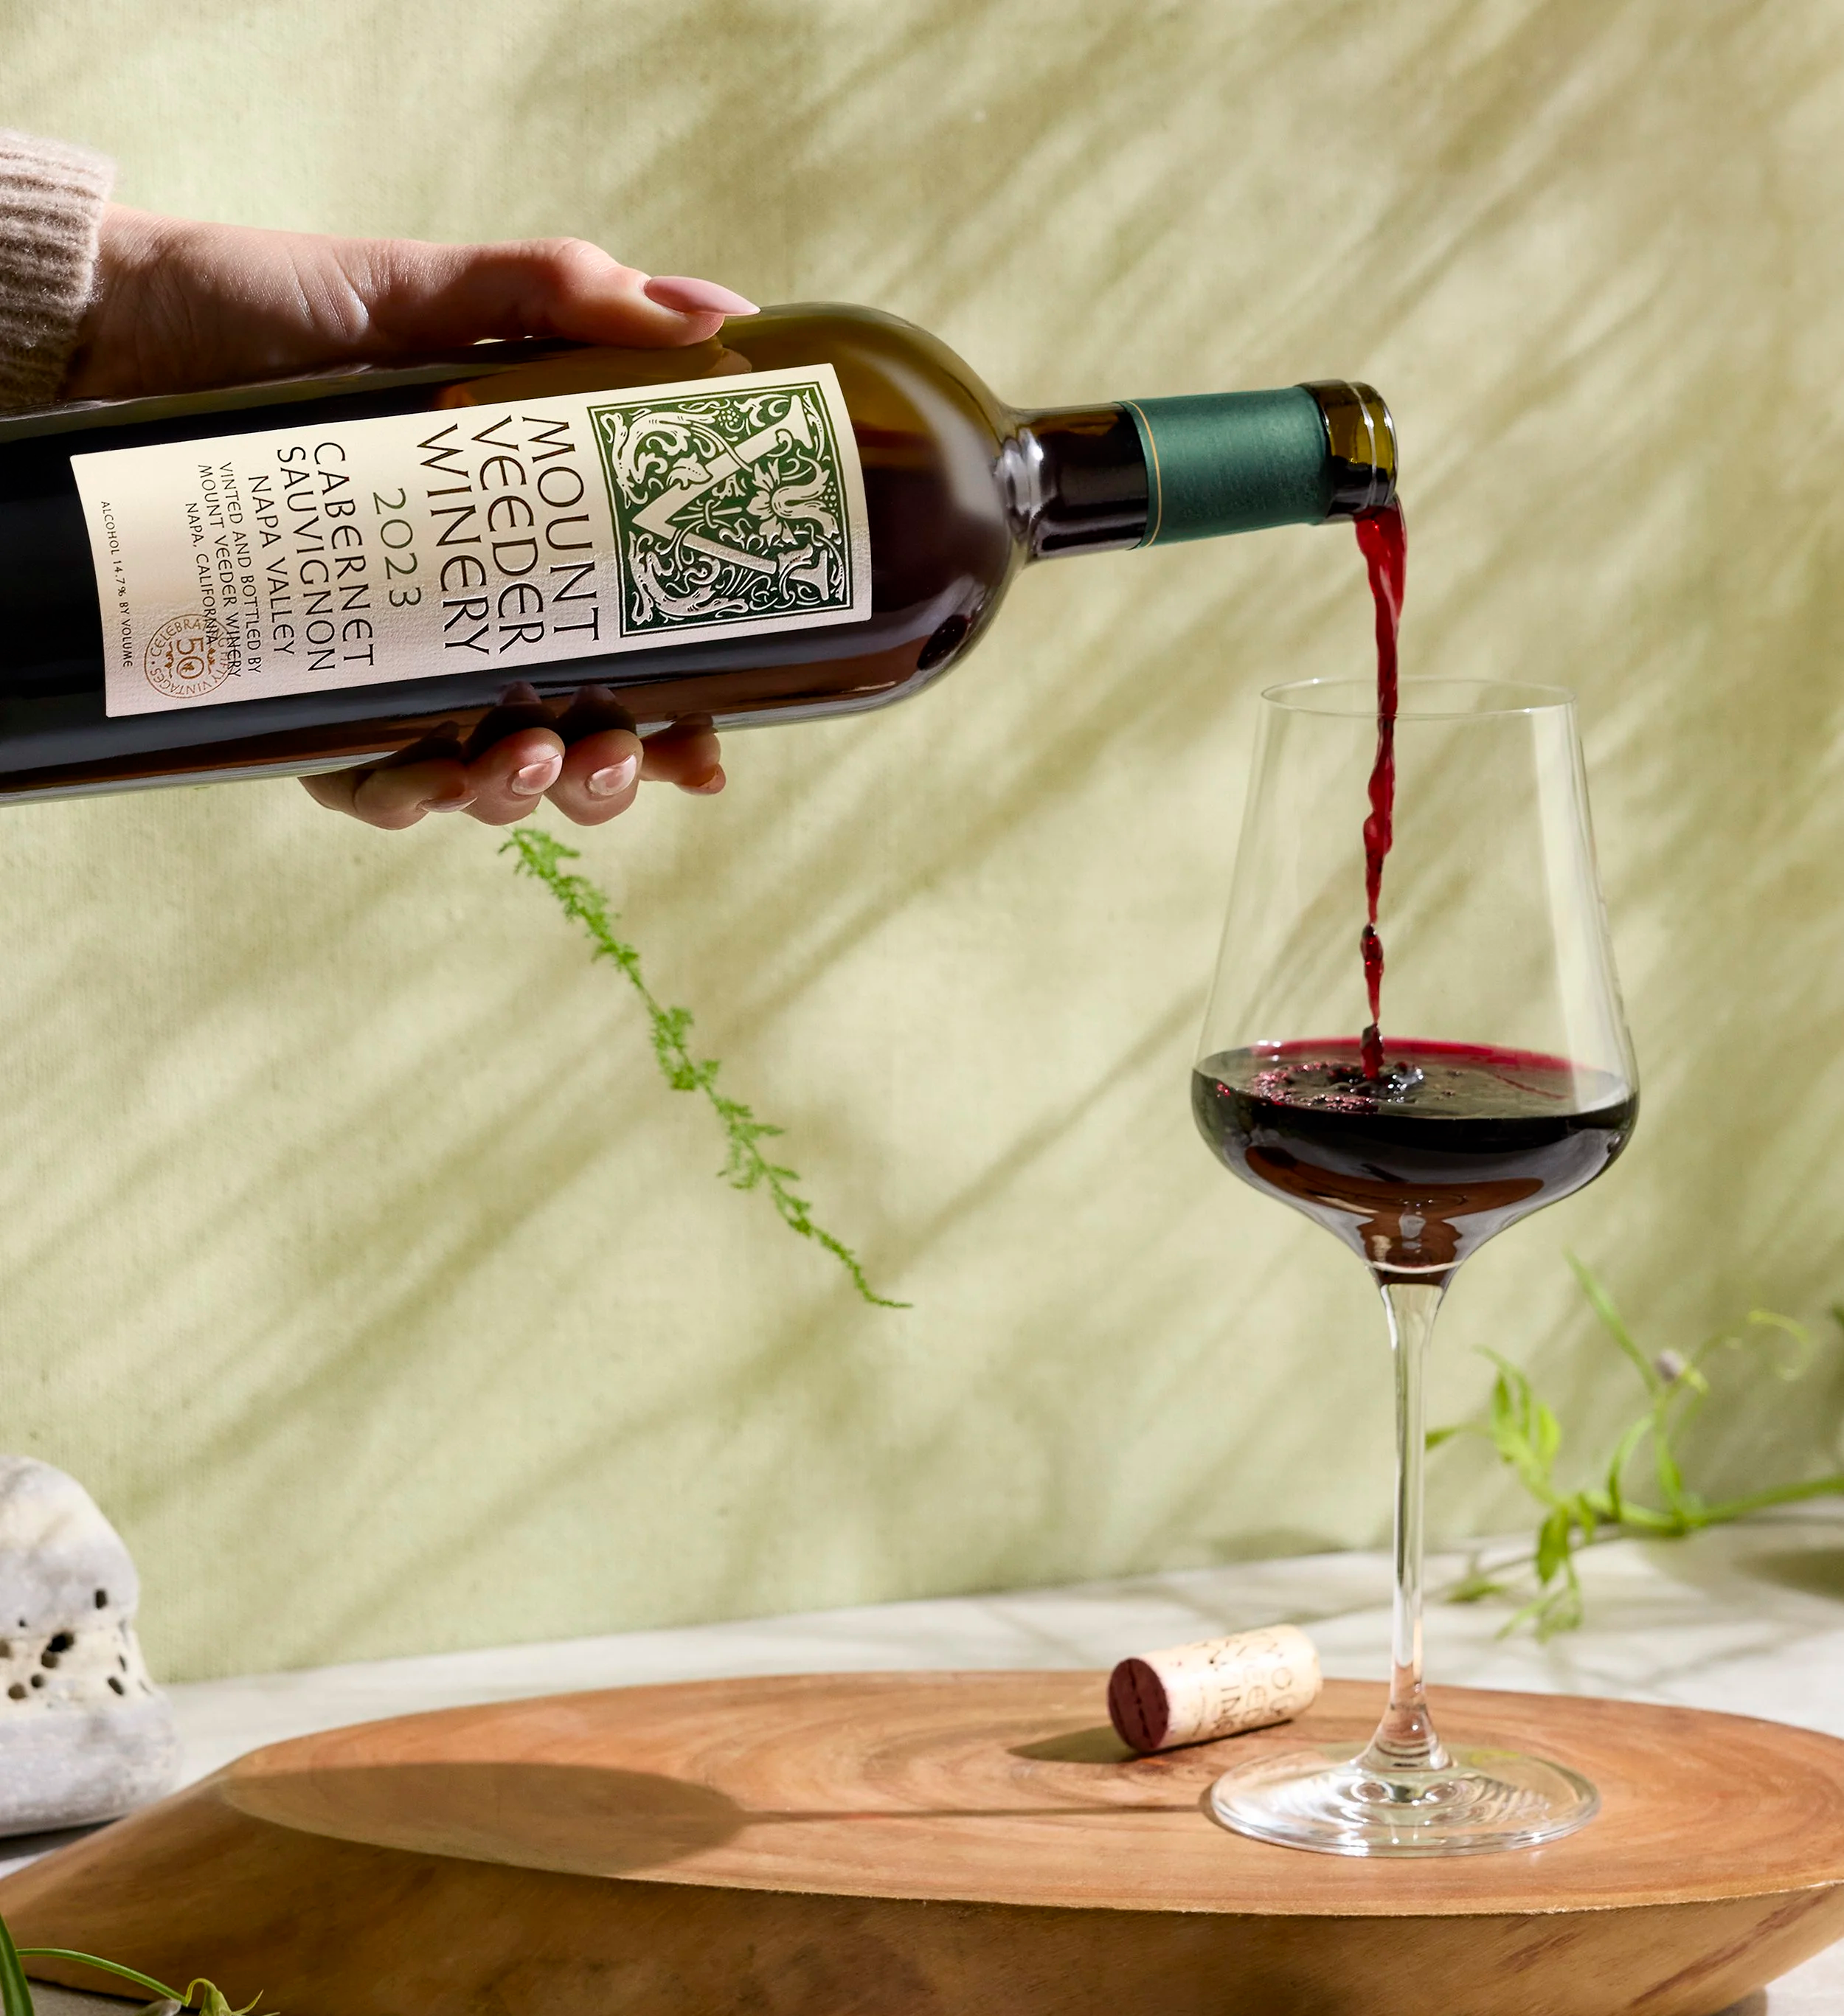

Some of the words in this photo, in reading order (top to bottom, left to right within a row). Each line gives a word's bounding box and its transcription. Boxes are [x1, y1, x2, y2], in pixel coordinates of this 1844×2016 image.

[220, 462, 243, 524] VINTED
[101, 501, 120, 555] ALCOHOL
[232, 531, 252, 567] AND
[277, 446, 336, 671] SAUVIGNON
[314, 442, 374, 666] CABERNET
[373, 488, 421, 607] 2023
[417, 423, 490, 655] WINERY
[471, 415, 545, 654] VEEDER
[521, 416, 599, 641] MOUNT
[113, 560, 125, 597] 14.7%
[185, 502, 204, 547] NAPA,
[196, 554, 218, 645] CALIFORNIA
[198, 465, 225, 528] MOUNT
[214, 535, 238, 607] VEEDER
[226, 612, 242, 677] WINERY
[249, 475, 282, 549] NAPA
[266, 557, 295, 655] VALLEY
[119, 602, 130, 615] BY
[150, 618, 229, 657] CELEBRATING
[240, 575, 261, 650] BOTTLED
[121, 619, 133, 668] VOLUME
[176, 637, 204, 679] 50
[248, 657, 261, 673] BY
[150, 668, 212, 695] VINTAGES
